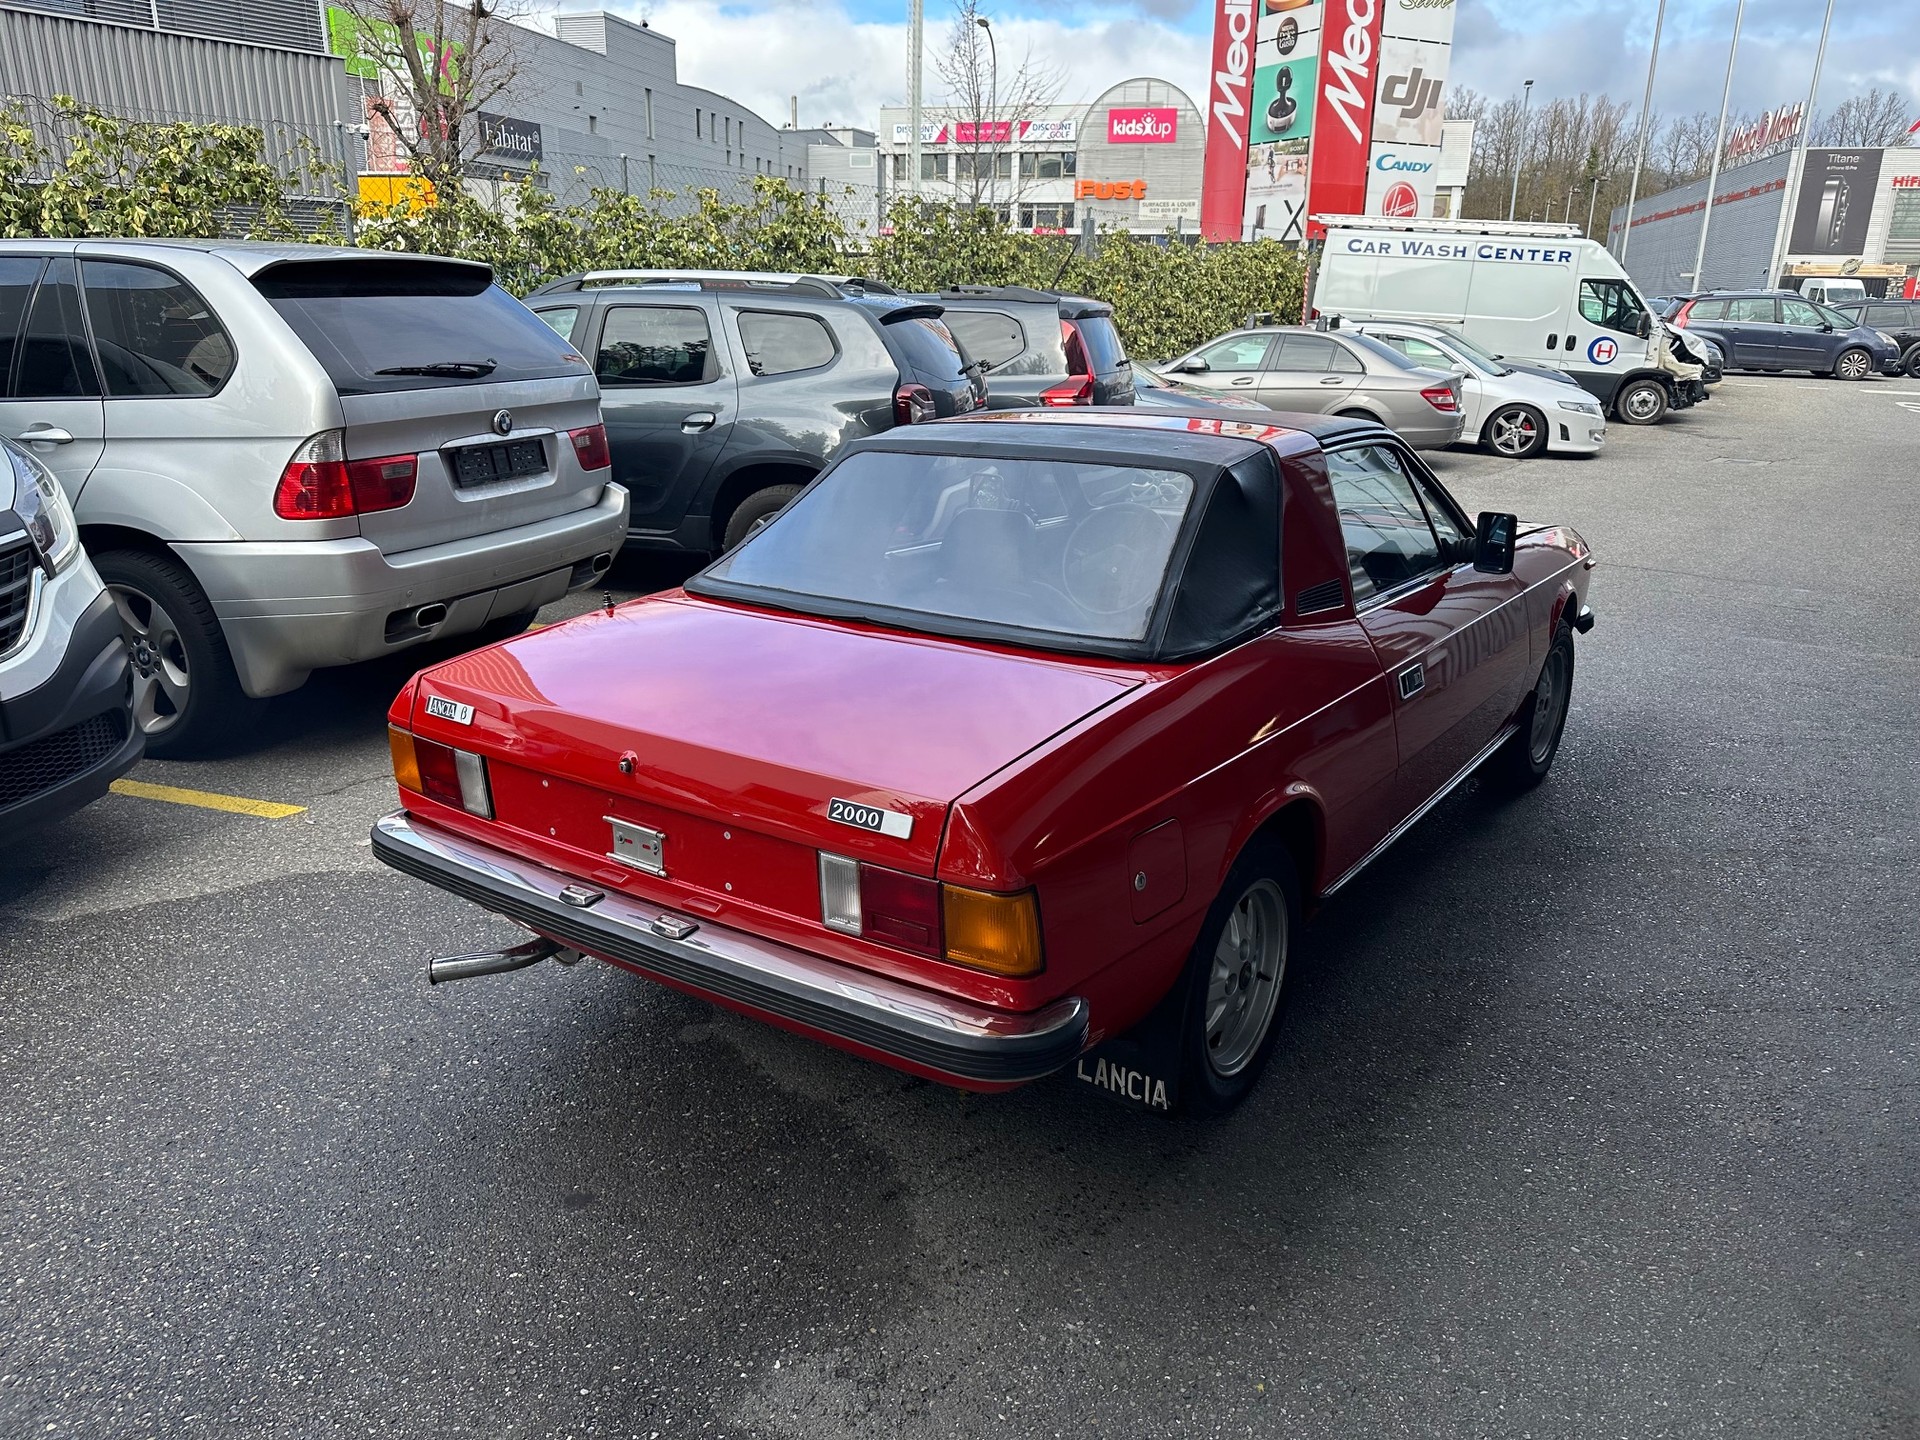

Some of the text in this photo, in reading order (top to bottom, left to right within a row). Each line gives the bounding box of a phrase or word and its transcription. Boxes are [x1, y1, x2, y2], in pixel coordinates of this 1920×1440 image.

[484, 120, 533, 153] habitat
[1032, 123, 1072, 131] DISCOUNT
[1049, 130, 1070, 139] GOLF
[1375, 154, 1433, 173] CANDY
[1828, 153, 1860, 163] Titane
[1347, 238, 1573, 263] CAR WASH CENTER
[831, 802, 880, 828] 2000
[1077, 1057, 1168, 1110] LANCIA
